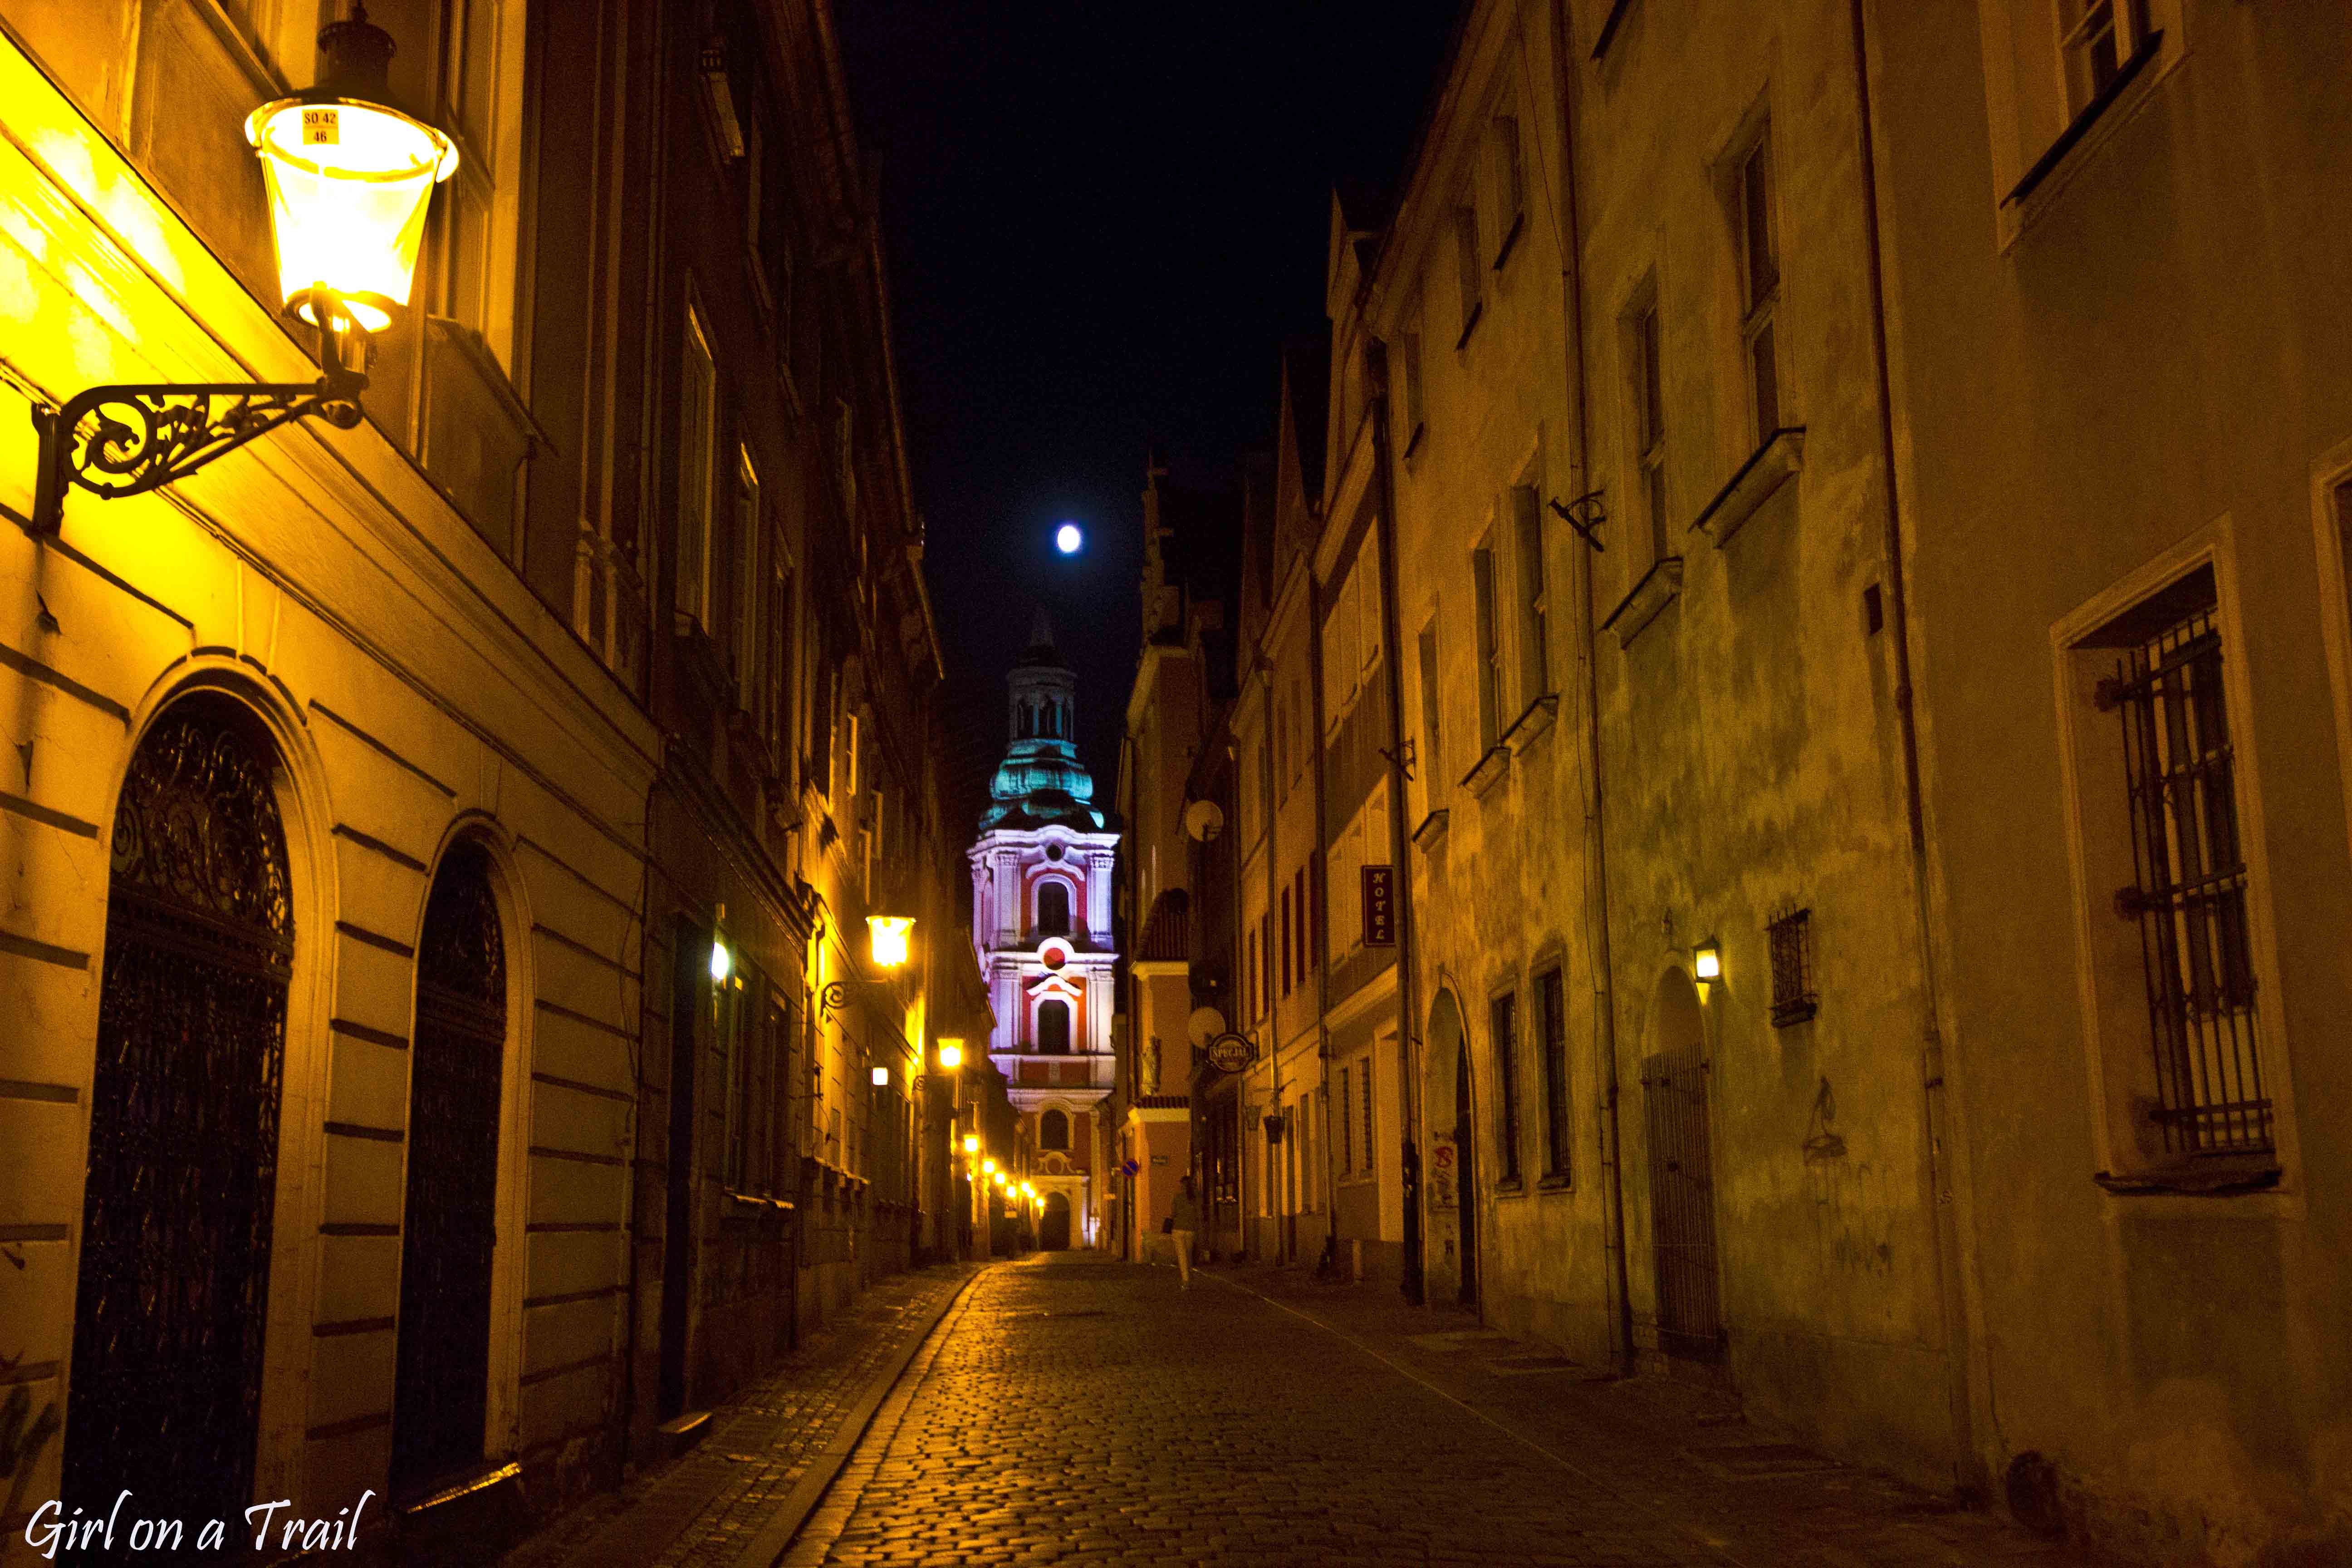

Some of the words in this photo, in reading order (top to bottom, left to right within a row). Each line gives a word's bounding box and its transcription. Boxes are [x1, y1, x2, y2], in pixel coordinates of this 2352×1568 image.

[323, 113, 336, 124] 42
[314, 131, 327, 142] 46
[1372, 872, 1386, 940] HOTEL
